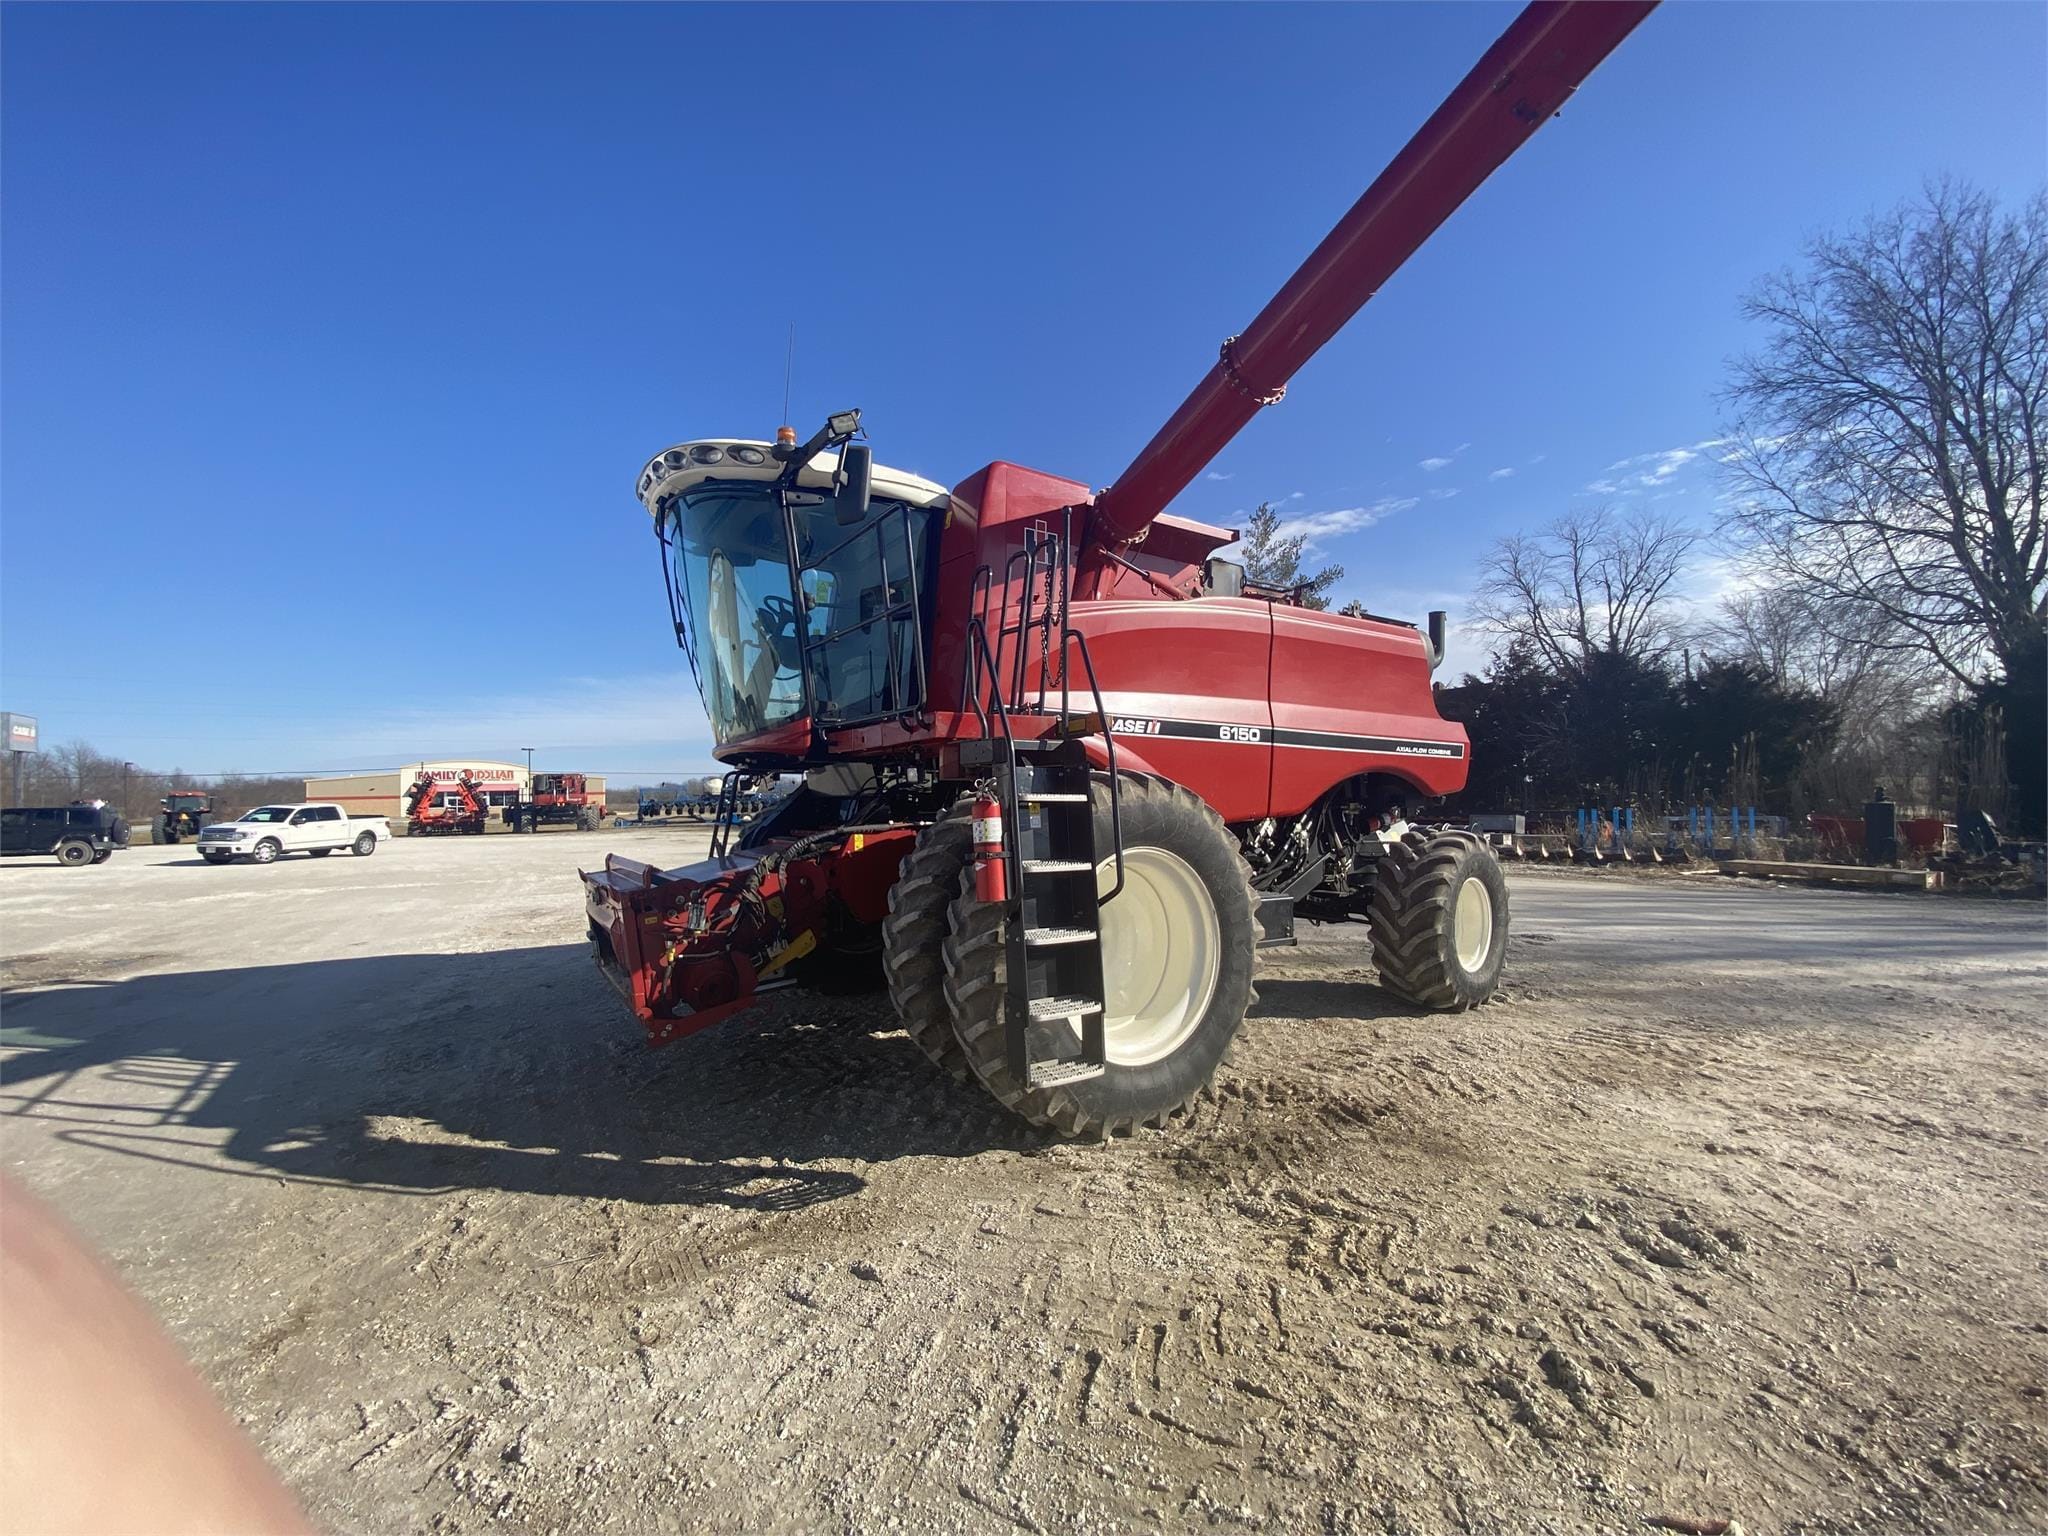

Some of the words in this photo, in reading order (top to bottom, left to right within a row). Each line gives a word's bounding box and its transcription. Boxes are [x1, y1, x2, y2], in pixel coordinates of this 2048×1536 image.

[1111, 719, 1145, 734] ASE
[1219, 725, 1261, 742] 6150
[416, 770, 458, 781] FAMILY
[476, 770, 514, 781] DOLLAR
